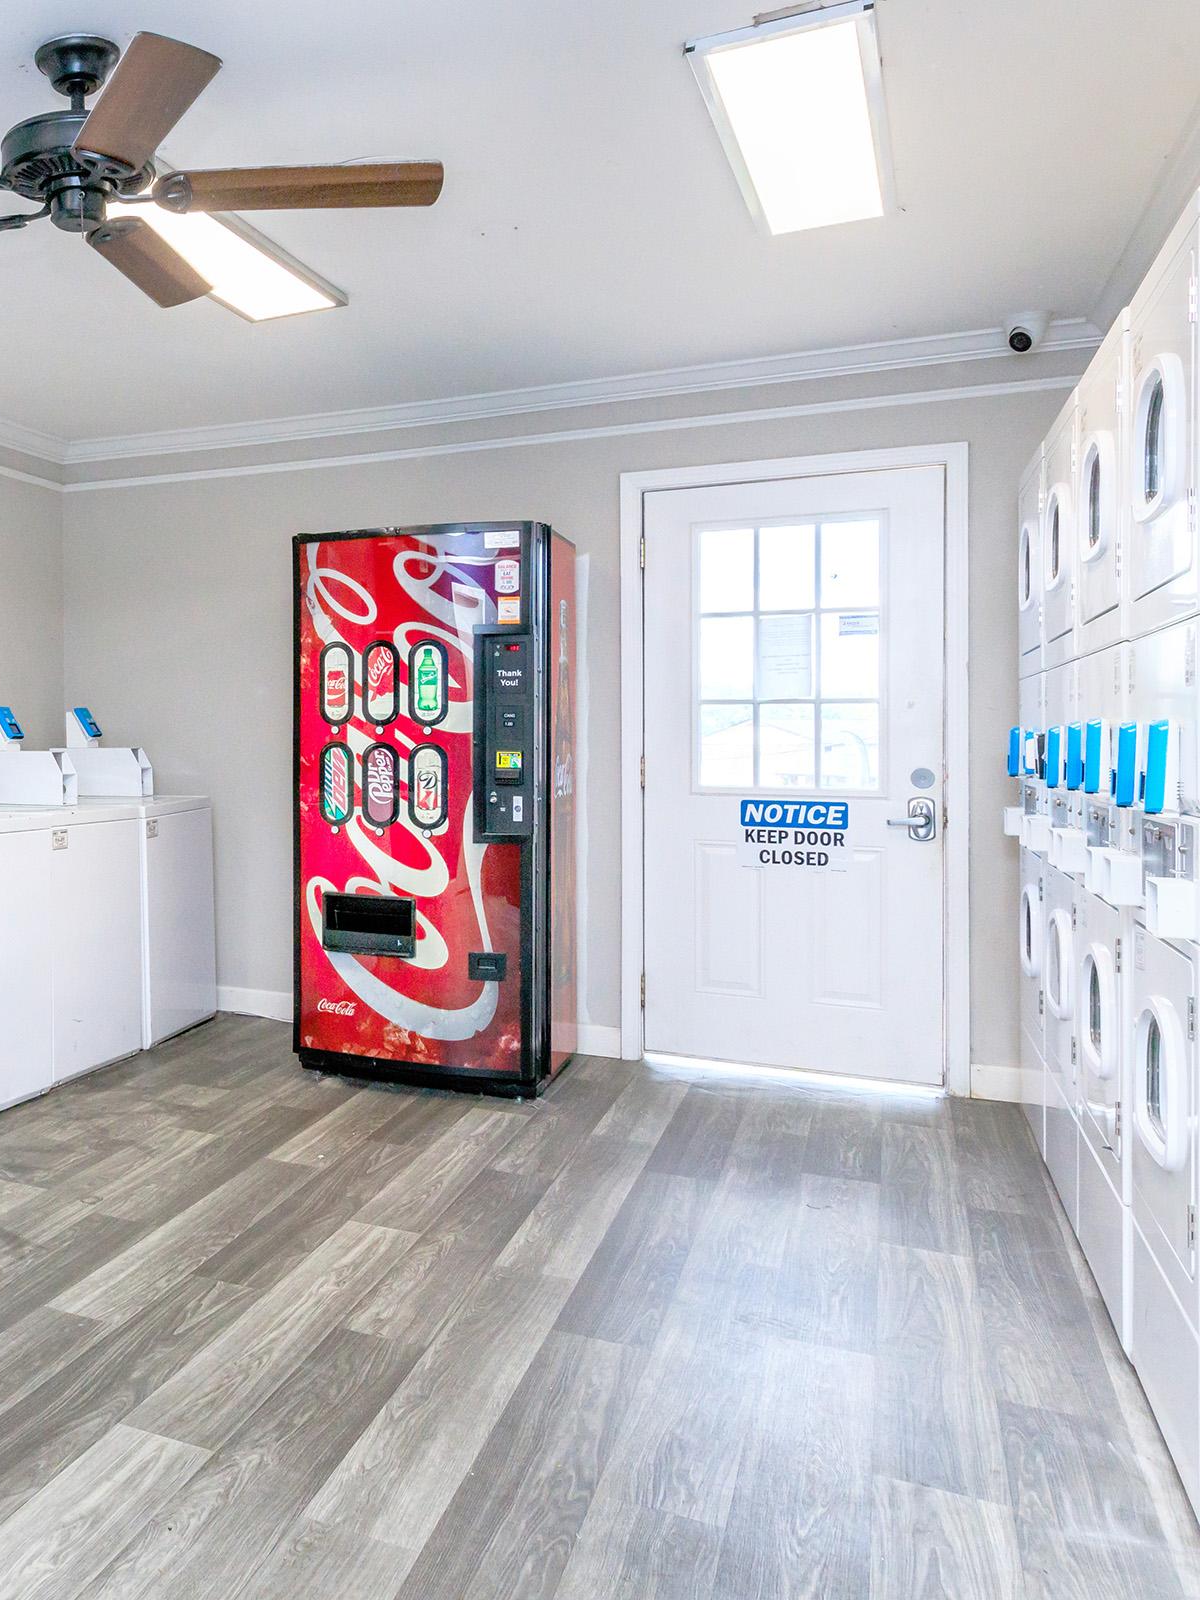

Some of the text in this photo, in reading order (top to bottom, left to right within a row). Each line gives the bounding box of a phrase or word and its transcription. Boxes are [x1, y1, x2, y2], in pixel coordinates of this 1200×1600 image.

[496, 669, 522, 677] Thank
[744, 803, 846, 825] NOTICE
[744, 829, 845, 847] KEEP DOOR
[759, 849, 829, 866] CLOSED
[317, 998, 357, 1016] Coca-Cola
